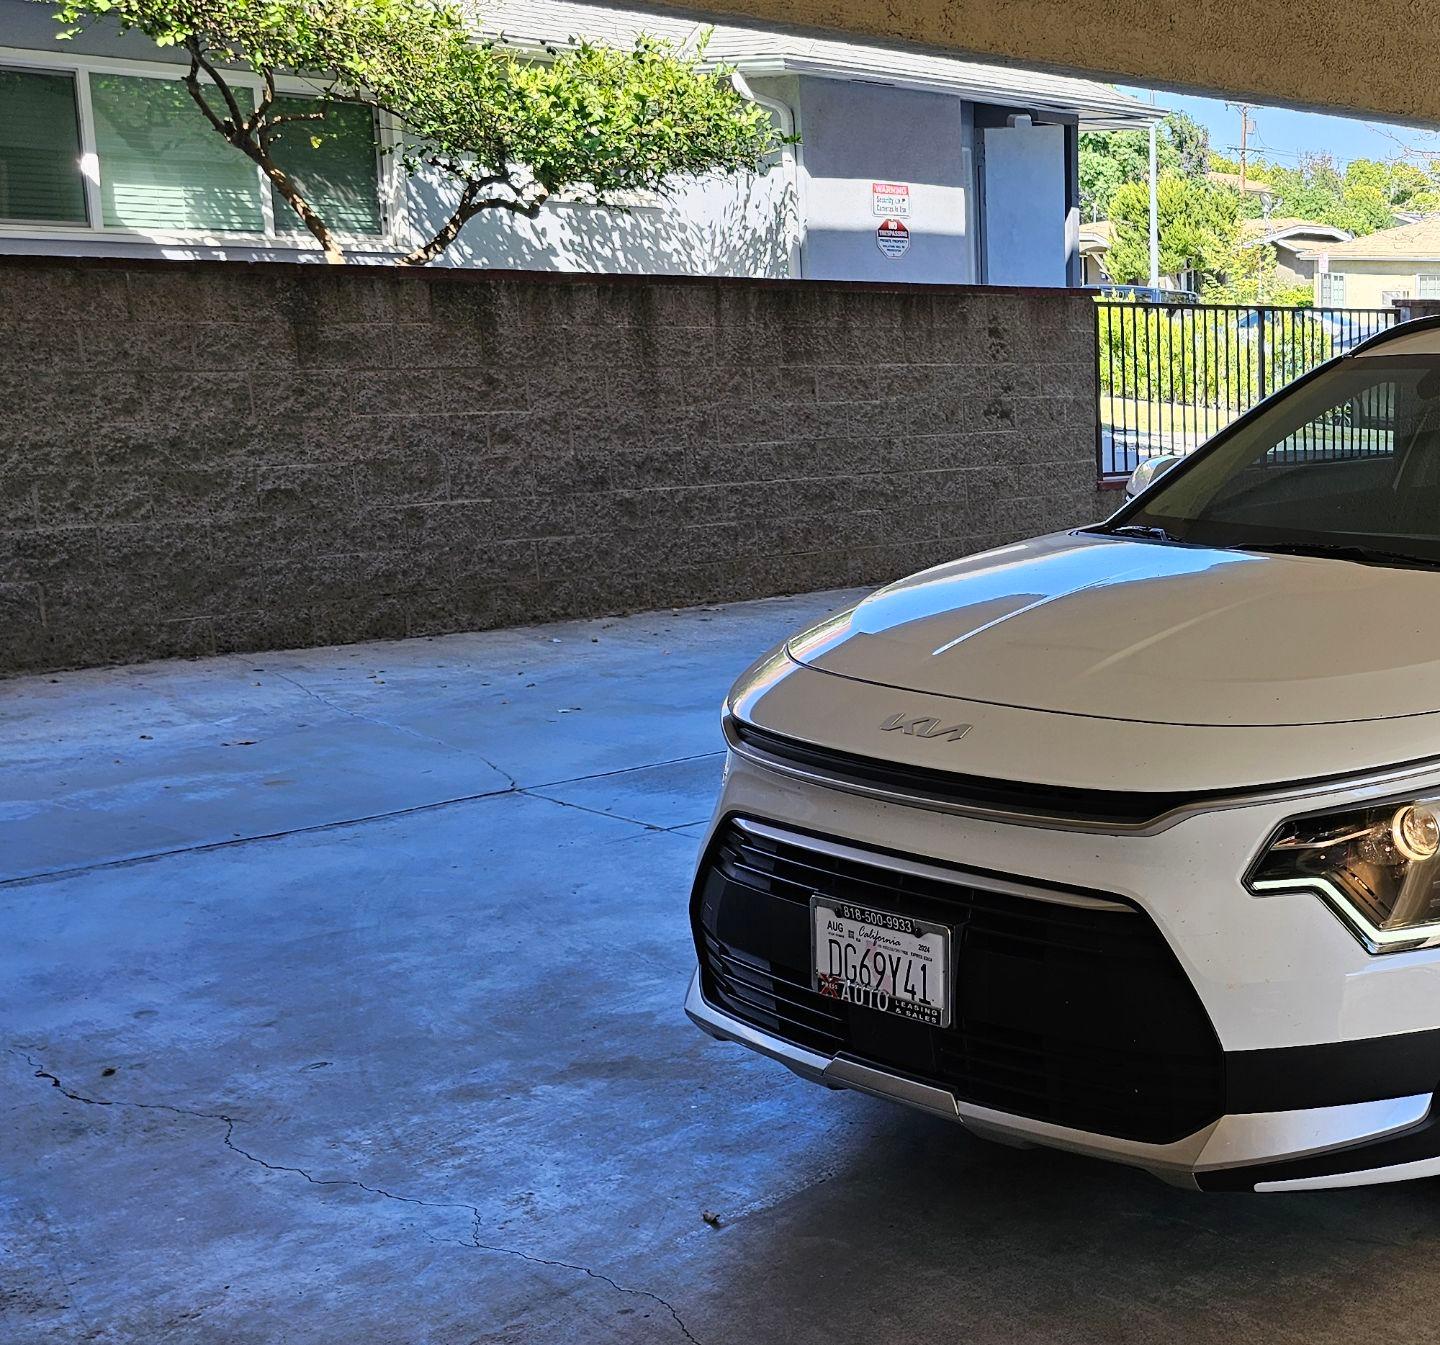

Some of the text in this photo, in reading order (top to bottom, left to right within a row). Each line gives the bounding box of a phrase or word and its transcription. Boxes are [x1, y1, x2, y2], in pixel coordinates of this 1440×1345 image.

[875, 185, 906, 194] WARNING
[876, 195, 893, 205] Security
[888, 221, 897, 229] NO
[879, 230, 907, 238] TRESPASSING
[880, 712, 973, 742] KIA
[827, 920, 844, 933] AUG
[843, 906, 912, 933] 818-500-9933
[859, 926, 901, 947] California
[828, 938, 932, 1005] DG69Y41
[841, 980, 890, 1012] AUTO
[895, 999, 938, 1016] LEASING
[905, 1010, 937, 1023] SALES
